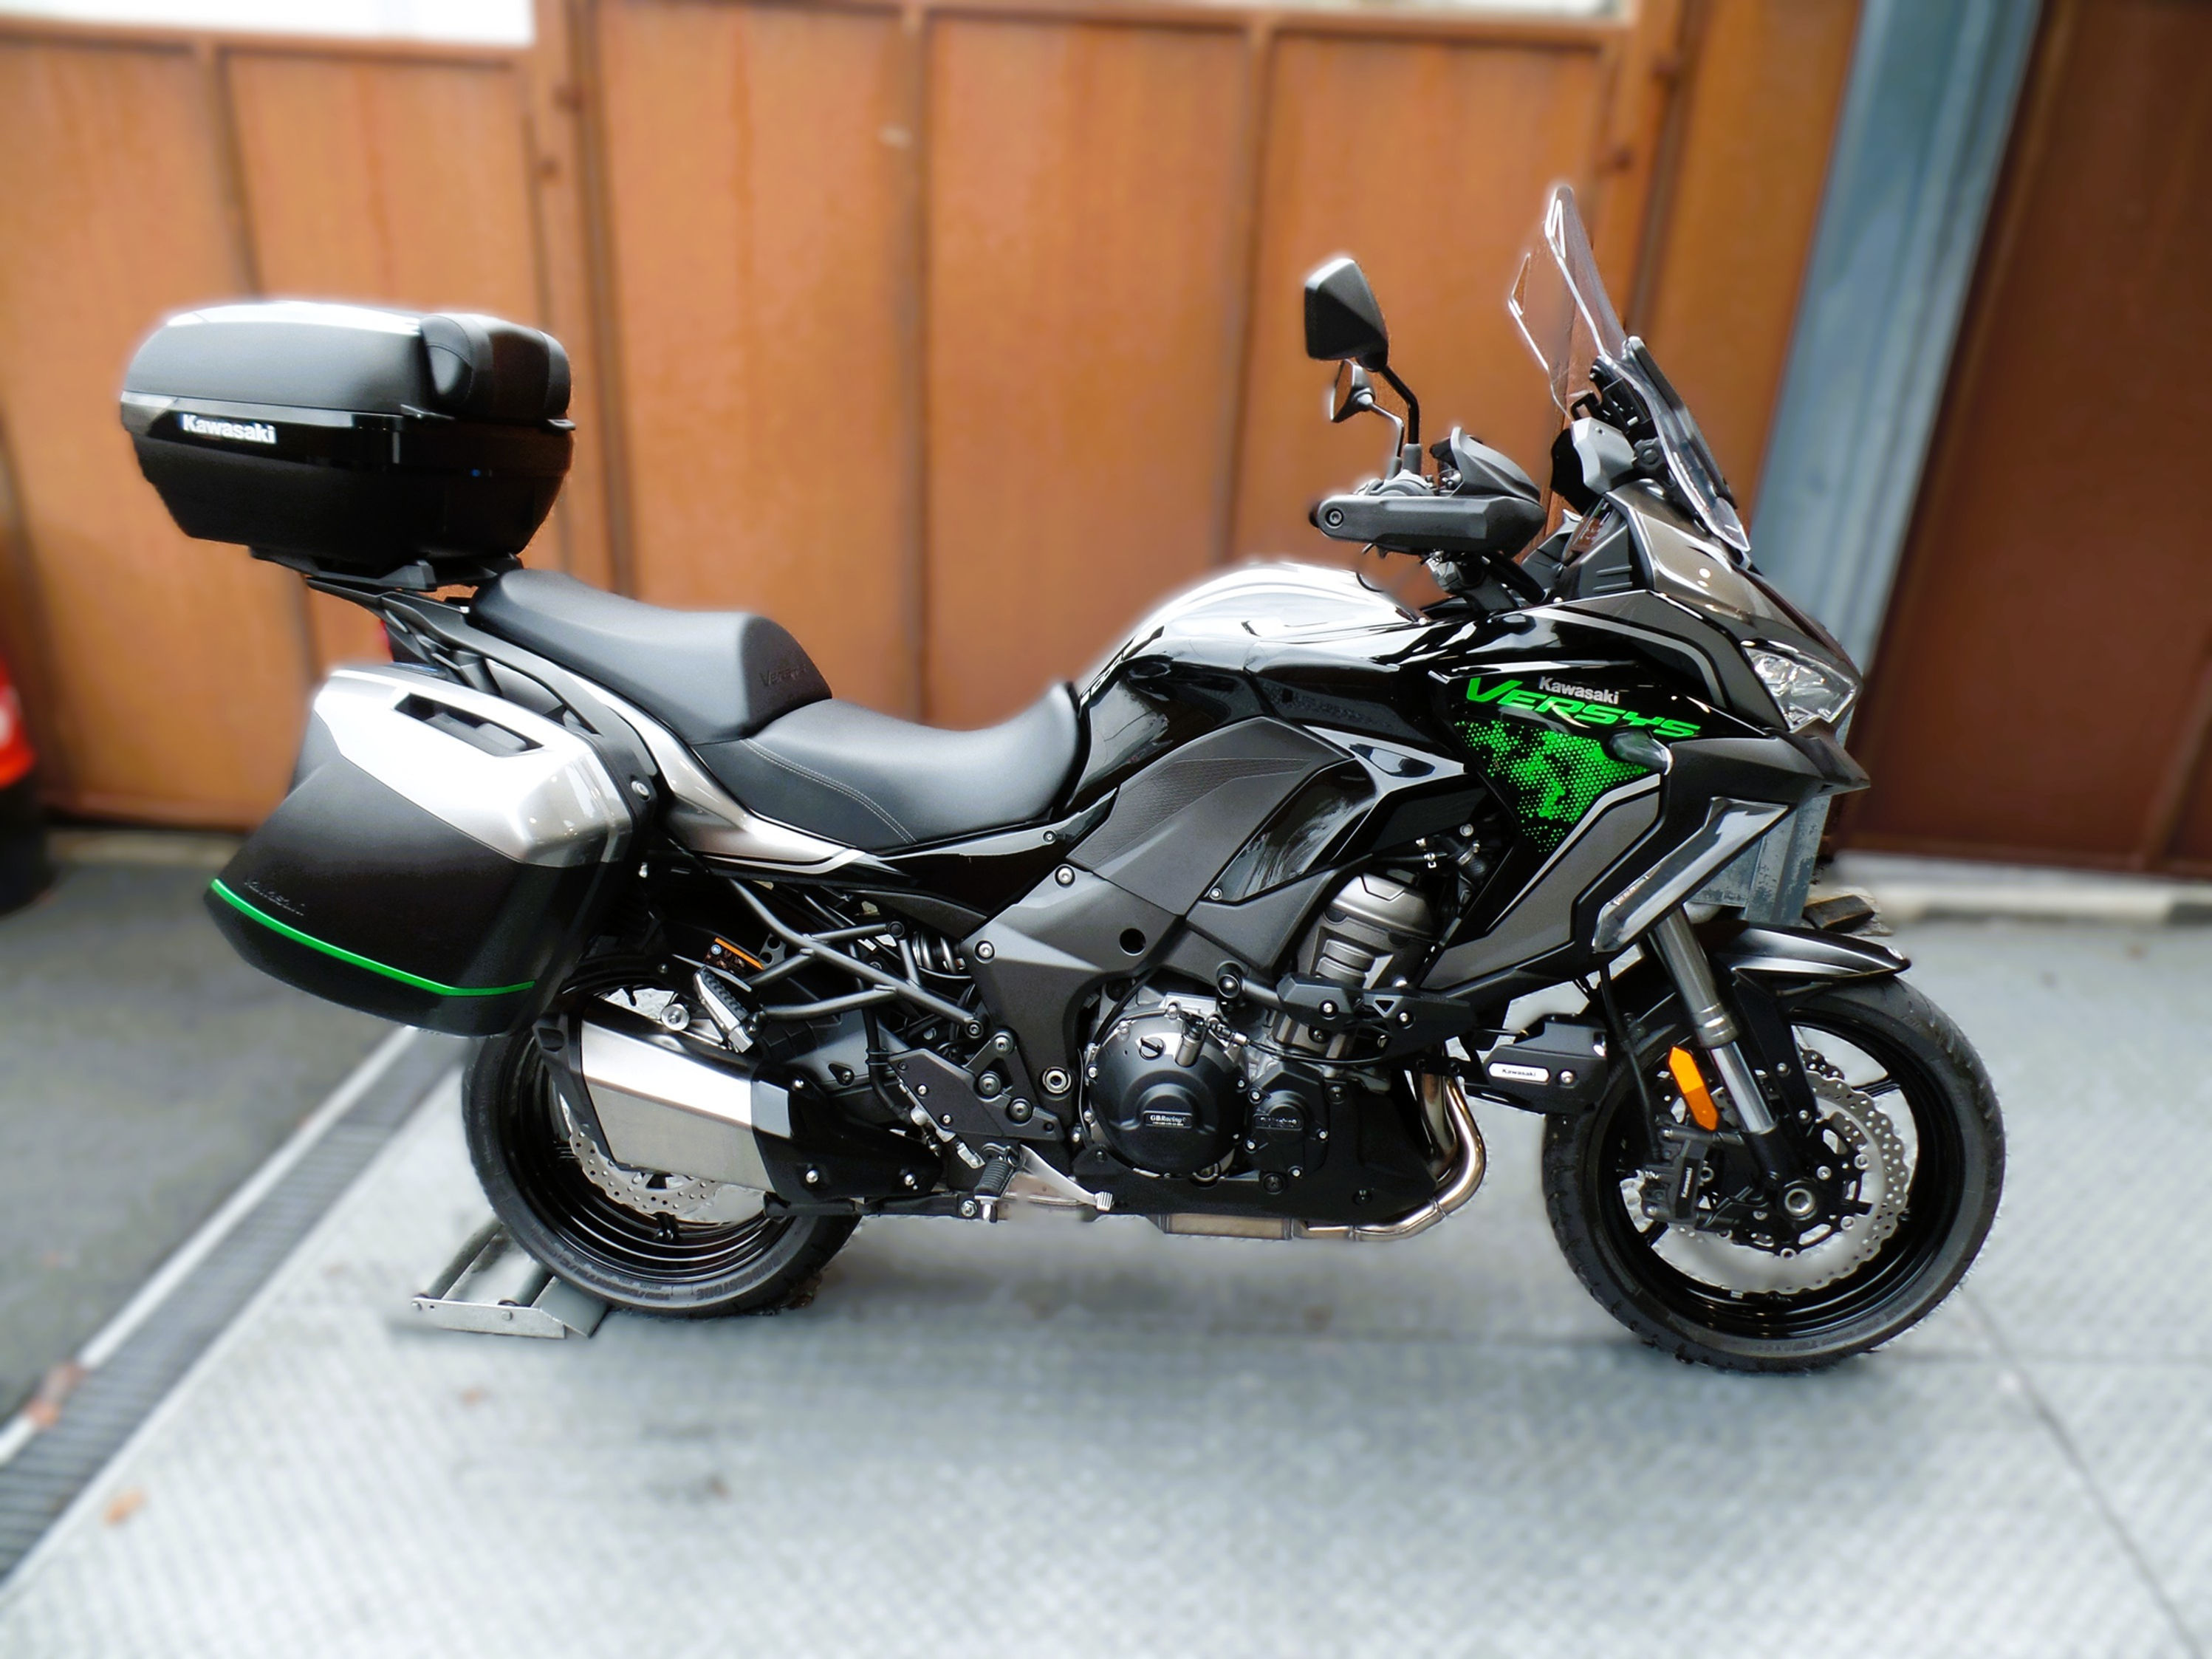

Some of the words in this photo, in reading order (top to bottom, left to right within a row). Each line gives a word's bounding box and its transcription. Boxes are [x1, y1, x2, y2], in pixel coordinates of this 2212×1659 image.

[182, 413, 277, 444] Kawasaki
[1538, 676, 1620, 704] Kawasaki
[1467, 677, 1701, 738] VERSYS
[1502, 1068, 1537, 1077] Kawasaki
